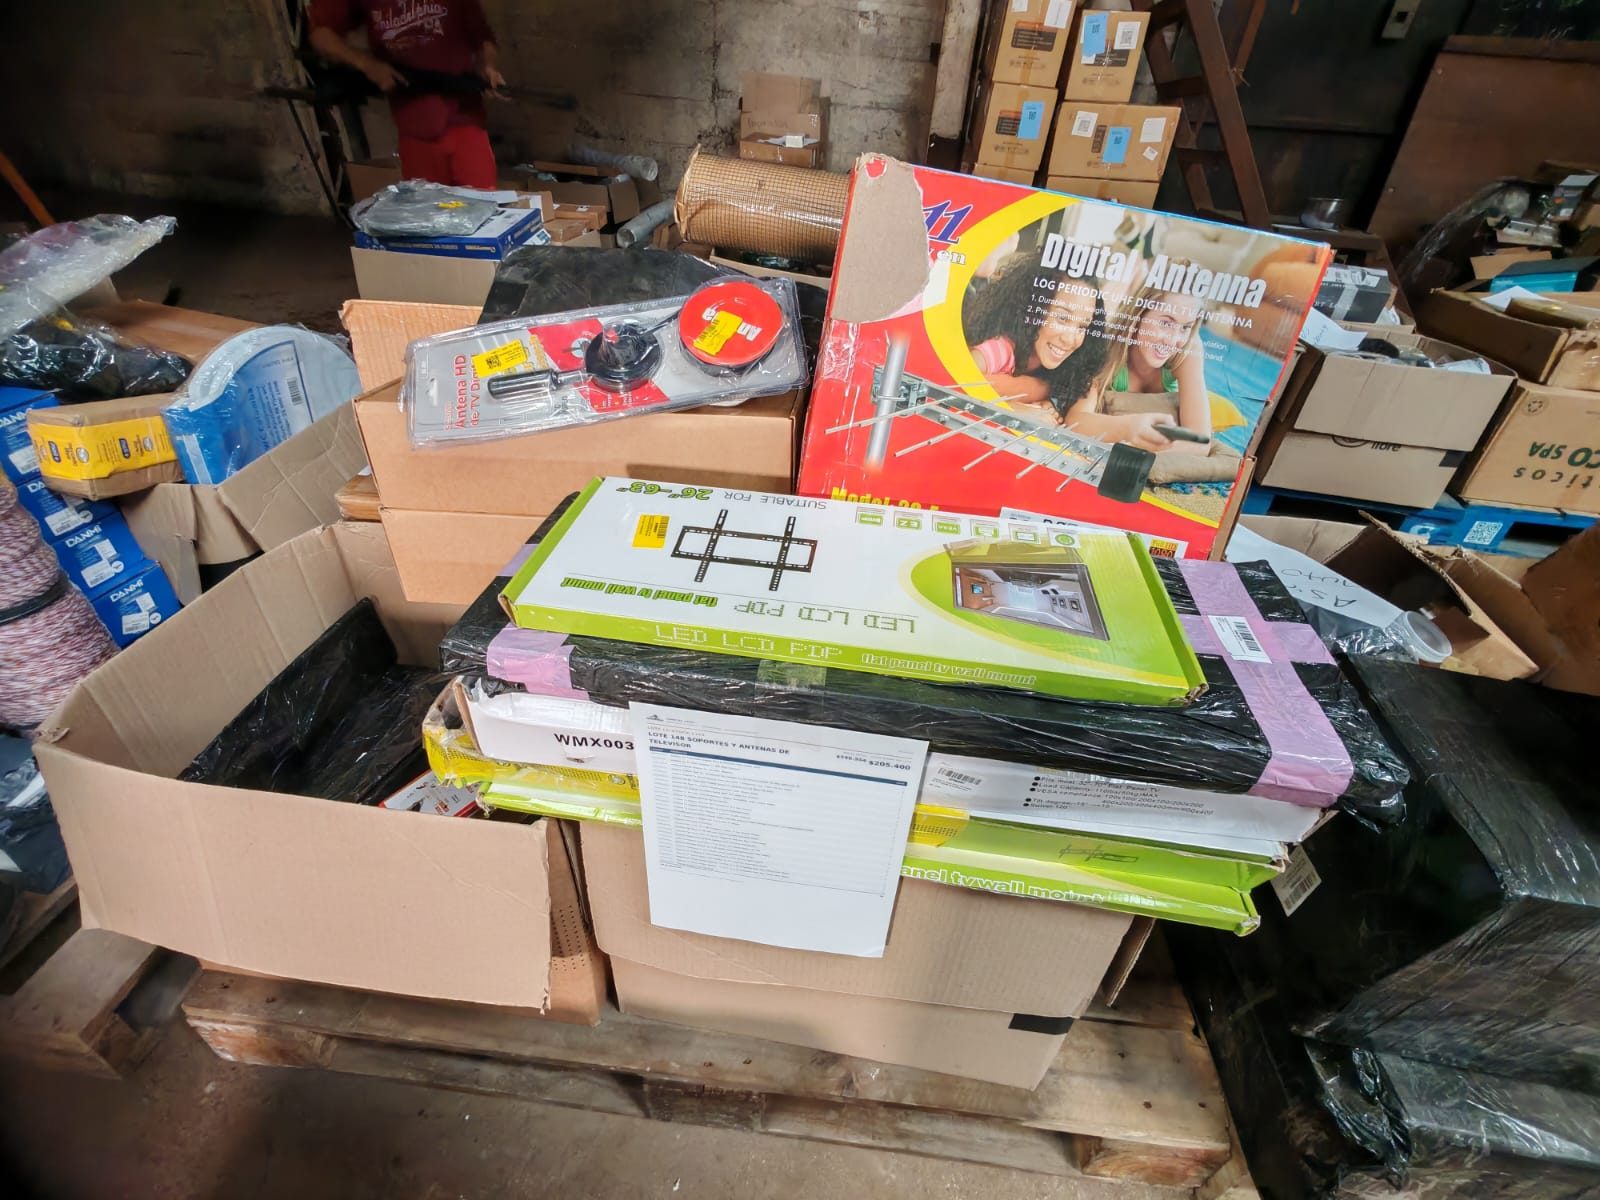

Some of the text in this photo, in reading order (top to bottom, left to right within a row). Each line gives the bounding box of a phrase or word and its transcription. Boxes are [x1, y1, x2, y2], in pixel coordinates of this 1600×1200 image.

[1040, 232, 1267, 308] Digital Antenna
[1033, 276, 1056, 291] LOG
[1057, 280, 1110, 301] PERIODIC
[1111, 293, 1134, 306] UHF
[1135, 298, 1178, 315] DIGITAL
[1197, 310, 1254, 329] ANTENNA
[1032, 317, 1049, 328] UHF
[453, 354, 468, 430] Antena HD
[470, 394, 480, 412] TV
[471, 411, 480, 427] de
[1528, 441, 1568, 460] SPA
[1512, 466, 1600, 489] ticos
[723, 490, 752, 503] FOR
[758, 495, 828, 510] SUITABLE
[560, 576, 719, 608] flat panel tv wall mount
[733, 599, 915, 633] LED LCD PDP
[654, 624, 844, 660] LED LCD PDP
[861, 653, 1038, 686] flat panel tv wall mount
[648, 731, 668, 739] LOTE
[687, 736, 730, 747] SOPORTES
[739, 743, 777, 753] ANTENAS
[649, 738, 692, 748] TELEVISOR
[868, 760, 912, 771] $205.400
[901, 865, 948, 883] anel
